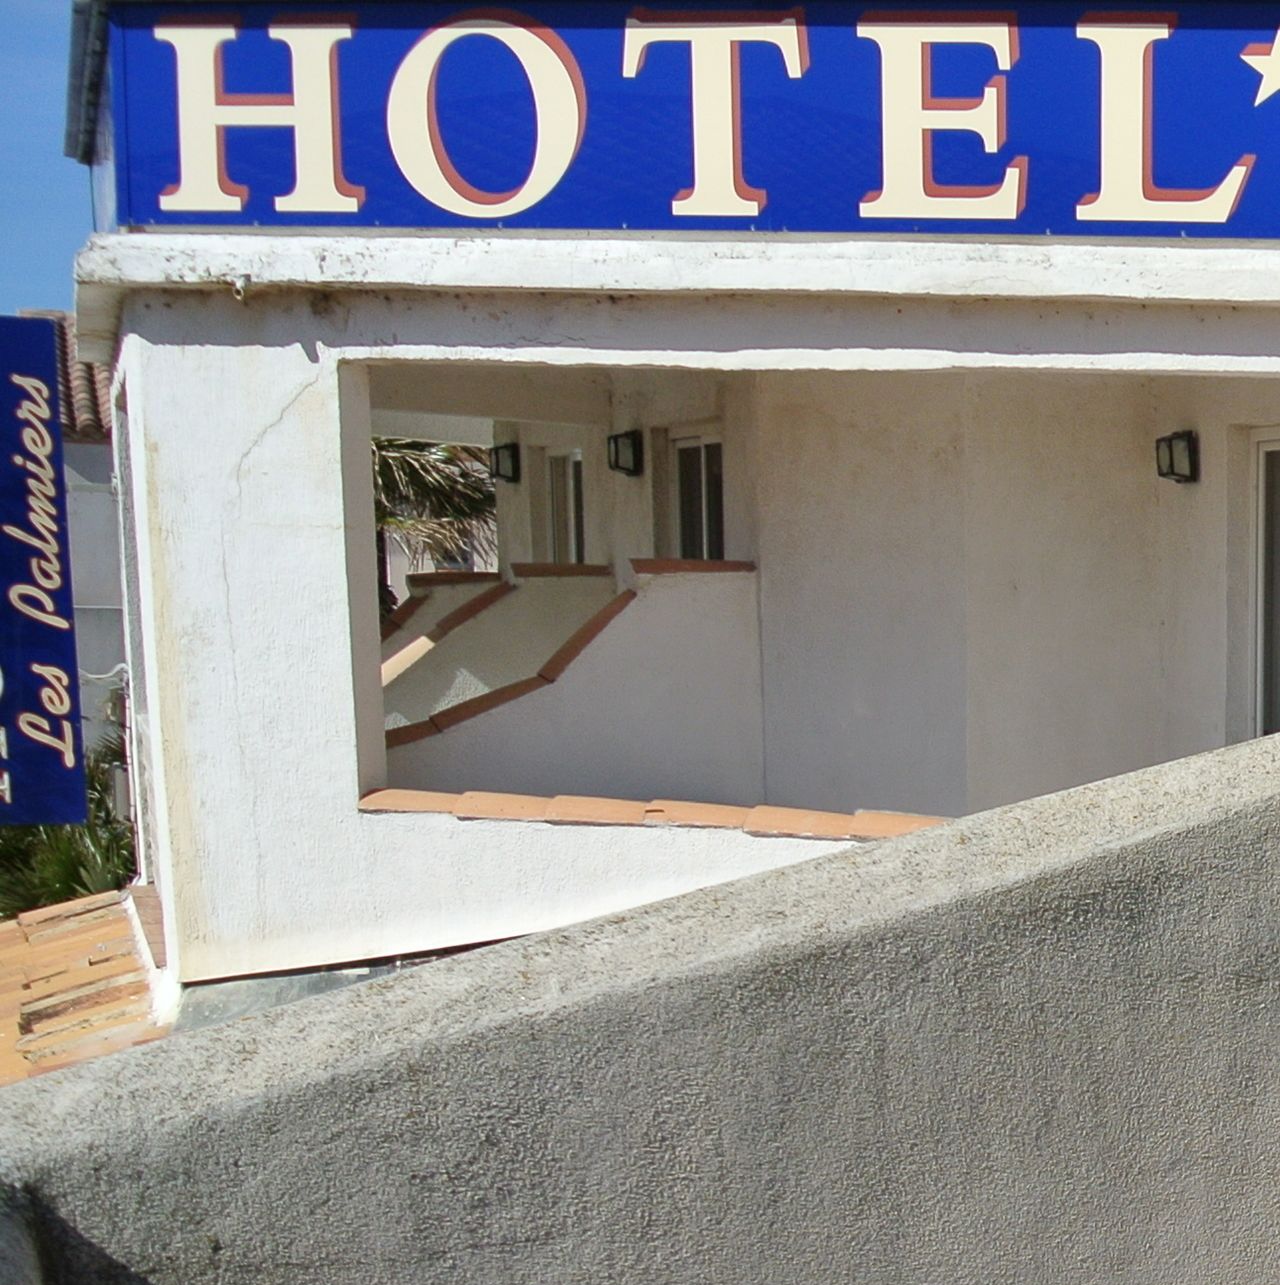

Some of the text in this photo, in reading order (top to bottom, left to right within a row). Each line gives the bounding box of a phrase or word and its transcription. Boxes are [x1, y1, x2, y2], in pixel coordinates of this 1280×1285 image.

[153, 13, 1257, 222] HOTEL
[2, 373, 76, 769] Les Palmiers
